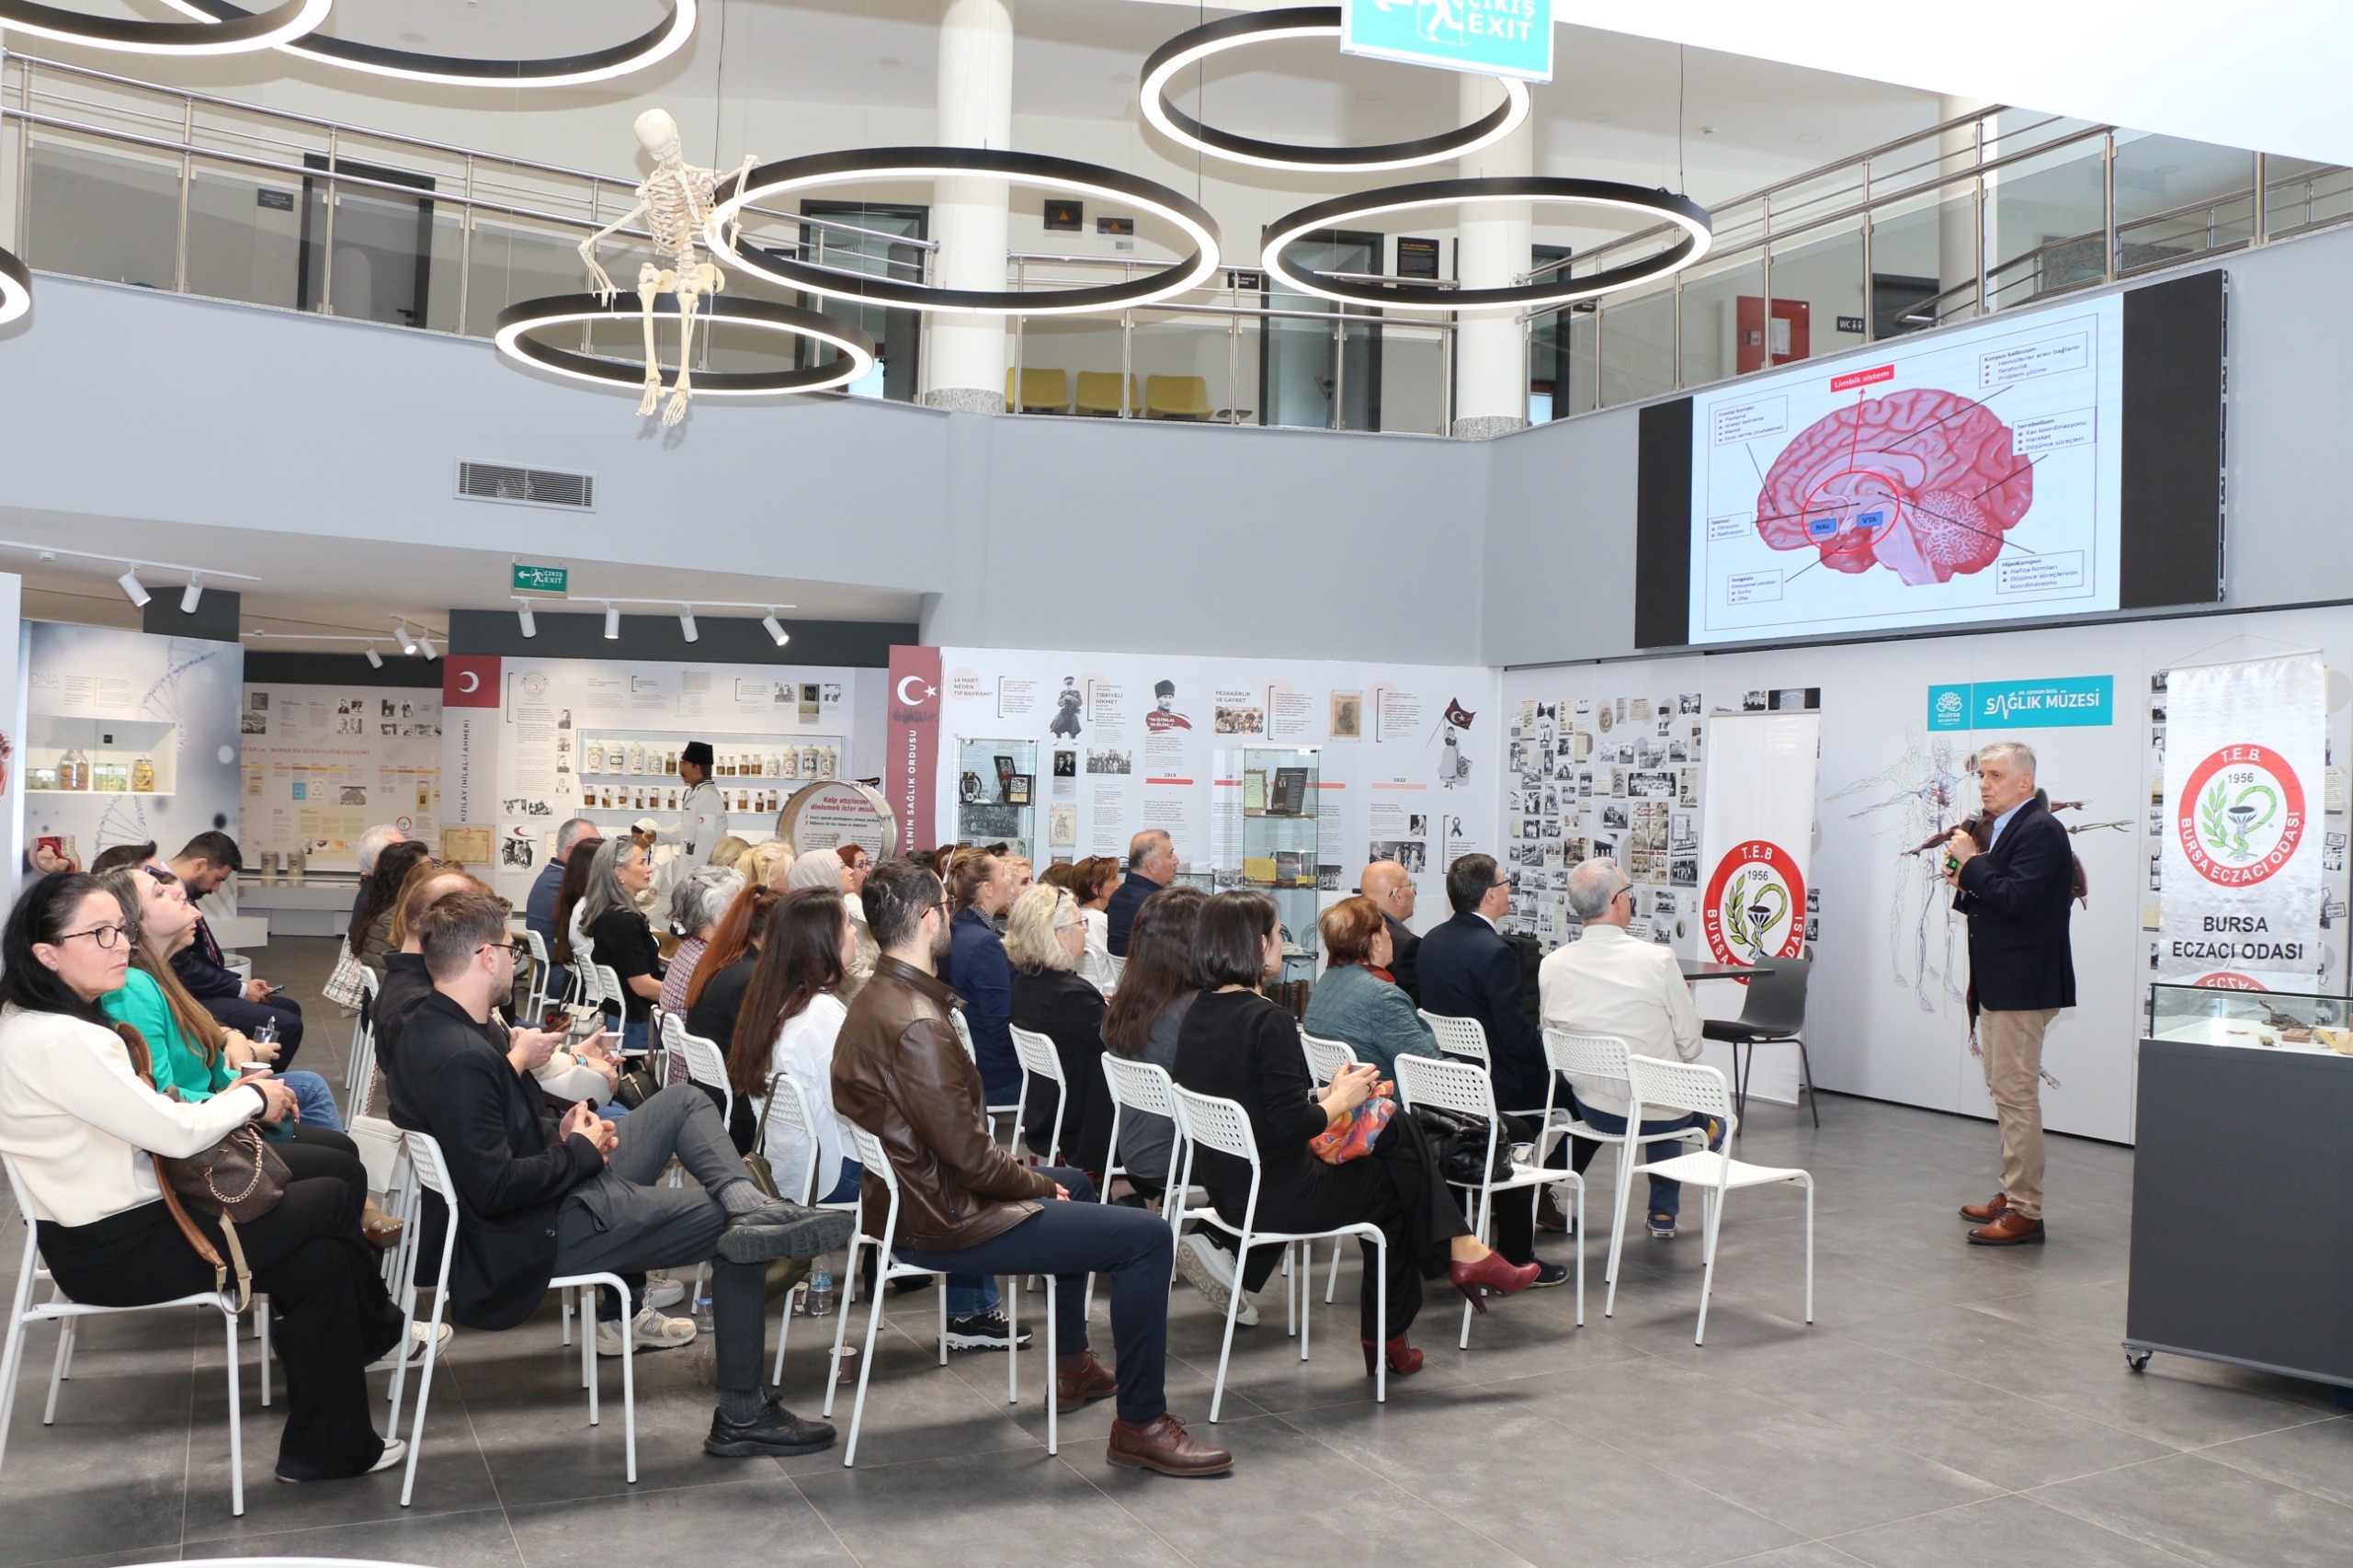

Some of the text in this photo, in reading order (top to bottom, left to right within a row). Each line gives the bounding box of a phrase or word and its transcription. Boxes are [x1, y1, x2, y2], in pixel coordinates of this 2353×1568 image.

[1469, 13, 1533, 41] EXIT
[1839, 320, 1850, 329] WC
[1984, 354, 2006, 362] Korpus
[1835, 370, 1890, 388] Limbik sistem
[1998, 372, 2024, 381] Problem
[2017, 419, 2054, 429] Serebellum
[2039, 420, 2087, 433] koordinasyonu
[2026, 434, 2052, 443] Hareket
[2026, 436, 2085, 451] Düşünce süreçleri
[2002, 559, 2041, 567] Hipokampus
[544, 570, 563, 578] ÇIKIŞ
[544, 576, 563, 585] EXIT
[2010, 580, 2057, 589] koordinasyonu
[30, 672, 60, 686] DNA
[1984, 688, 2099, 720] SAĞLIK MÜZESİ
[462, 720, 471, 752] AHMER)
[2221, 747, 2261, 763] T.E.B.
[2227, 773, 2255, 783] 1956
[905, 730, 917, 851] LENİN SAĞLIK ORDUSU
[460, 790, 469, 823] KIZILAY
[811, 803, 841, 812] dinlemek
[1741, 845, 1773, 860] T.E.B
[2181, 812, 2301, 882] BURSA ECZACI ODASI
[1747, 869, 1768, 881] 1956
[2203, 916, 2268, 933] BURSA
[1707, 909, 1730, 965] BURSA
[2173, 941, 2302, 960] ECZACI ODASI
